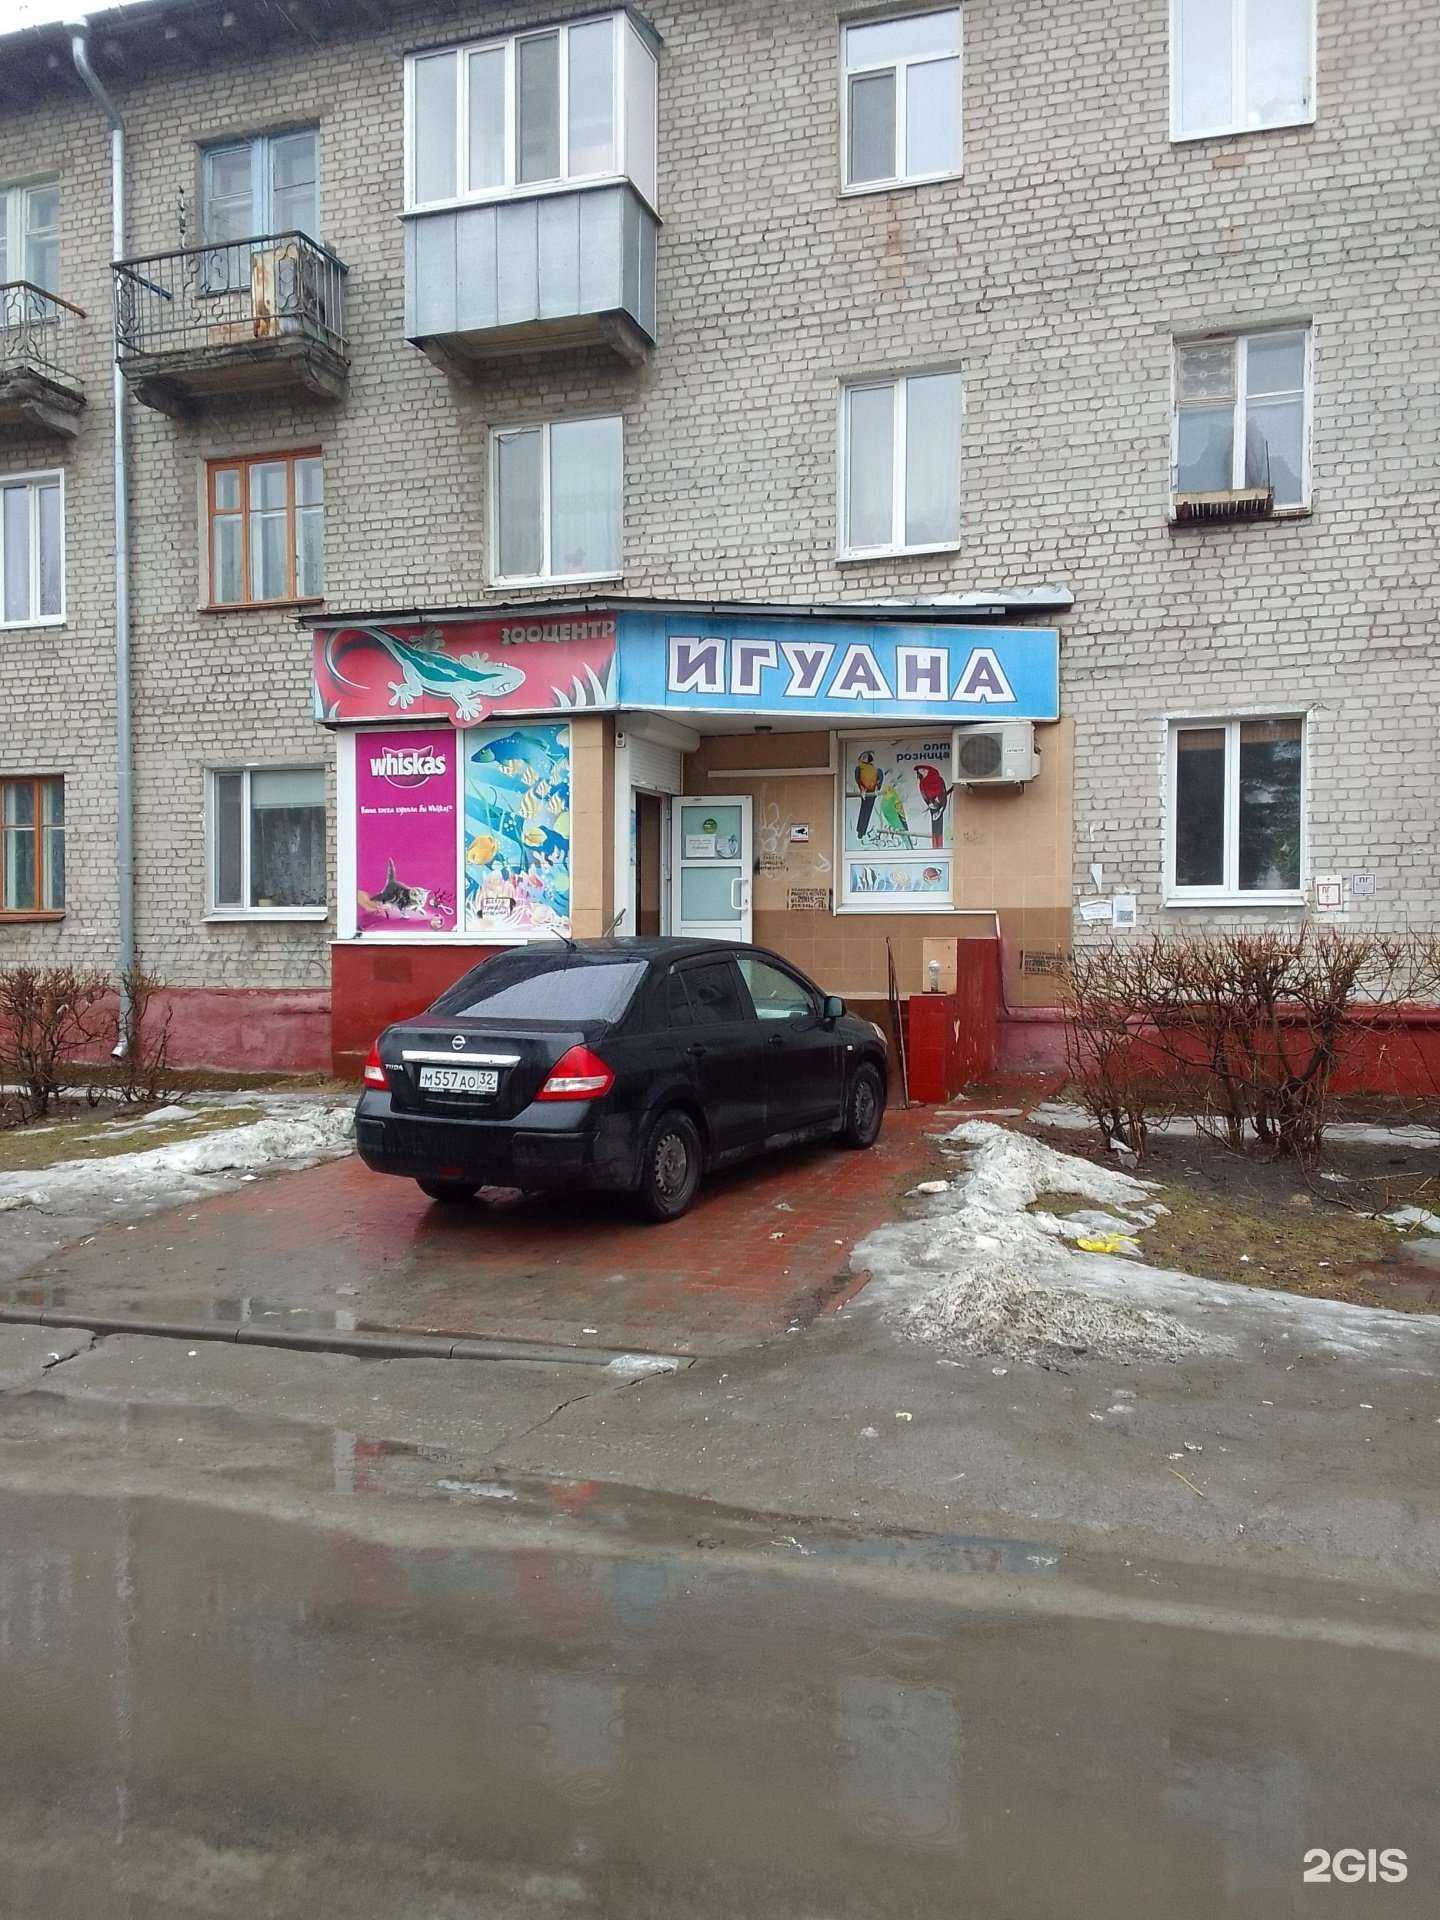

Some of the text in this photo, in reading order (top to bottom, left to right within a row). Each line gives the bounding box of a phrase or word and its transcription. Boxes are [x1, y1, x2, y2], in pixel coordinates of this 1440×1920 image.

[501, 619, 615, 646] ЗООЦЕНТР
[667, 636, 1018, 703] ИГУАНА
[923, 742, 951, 751] опт
[370, 752, 446, 776] whiskas
[896, 751, 950, 764] розница
[480, 1072, 493, 1085] 32
